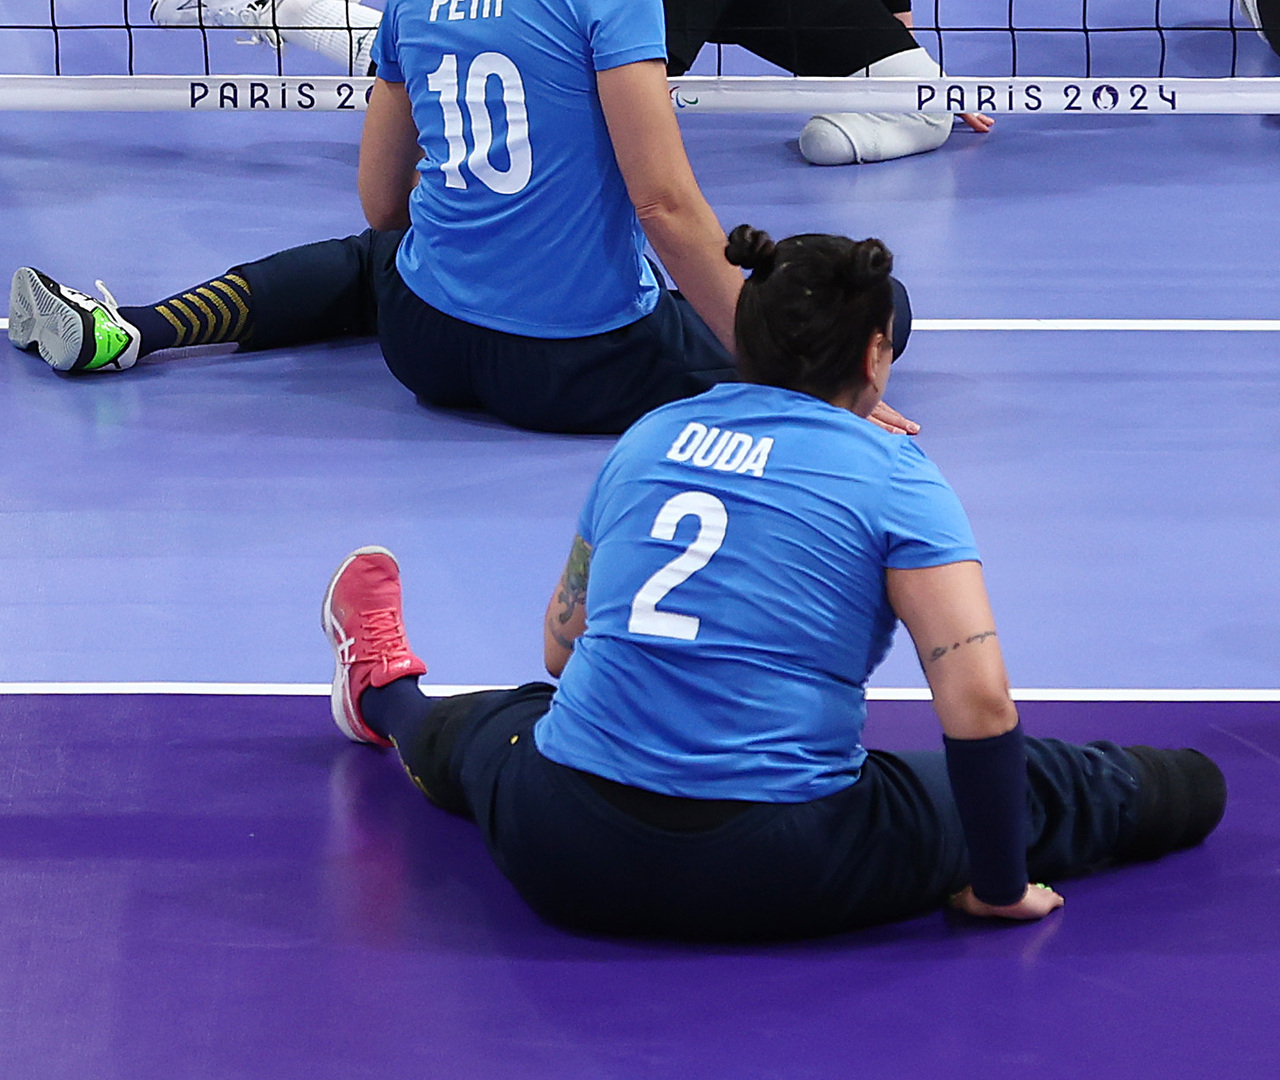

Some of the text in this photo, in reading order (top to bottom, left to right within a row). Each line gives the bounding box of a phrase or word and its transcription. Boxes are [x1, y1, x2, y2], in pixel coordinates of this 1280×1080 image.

[426, 51, 533, 195] 10
[1062, 83, 1177, 111] 2024
[665, 420, 775, 478] DUDA
[627, 490, 729, 641] 2
